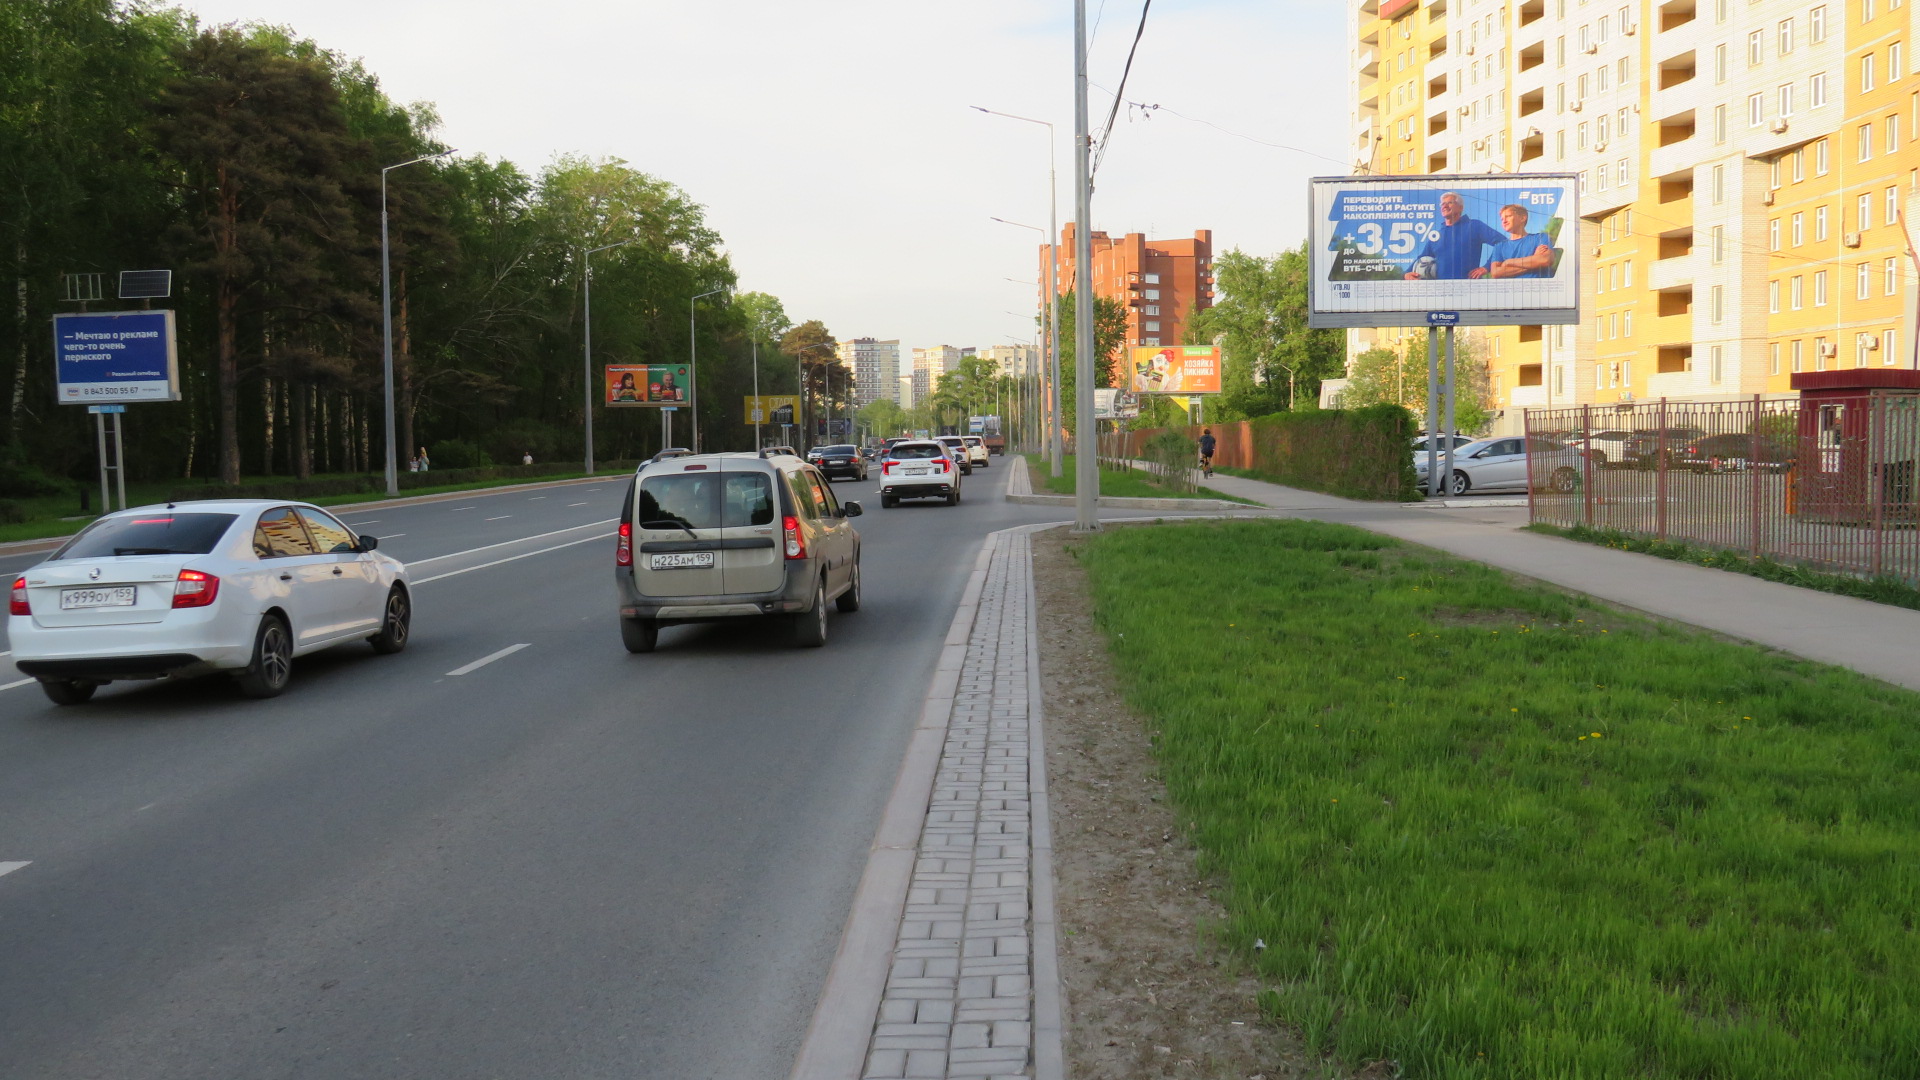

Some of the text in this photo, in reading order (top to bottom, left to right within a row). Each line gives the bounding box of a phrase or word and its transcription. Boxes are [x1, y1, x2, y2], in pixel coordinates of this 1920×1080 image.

[1343, 196, 1403, 204] ПЕРЕВОДИТЕ
[1531, 193, 1555, 205] ВТБ
[1343, 204, 1383, 212] ПЕНСИЮ
[1394, 203, 1436, 211] РАСТИТЕ
[1343, 212, 1405, 220] НАКОПЛЕНИЯ
[75, 331, 111, 340] Мечтаю
[120, 330, 158, 340] рекламе
[64, 342, 126, 351] чего-то очень
[64, 353, 112, 362] пермского
[1184, 358, 1214, 368] ХОЗЯЙКА
[1184, 368, 1214, 376] ПИКНИКА
[105, 387, 118, 395] 500
[130, 386, 139, 394] 67
[769, 397, 794, 409] СТАРТ
[695, 553, 711, 562] 159
[113, 588, 131, 598] 159
